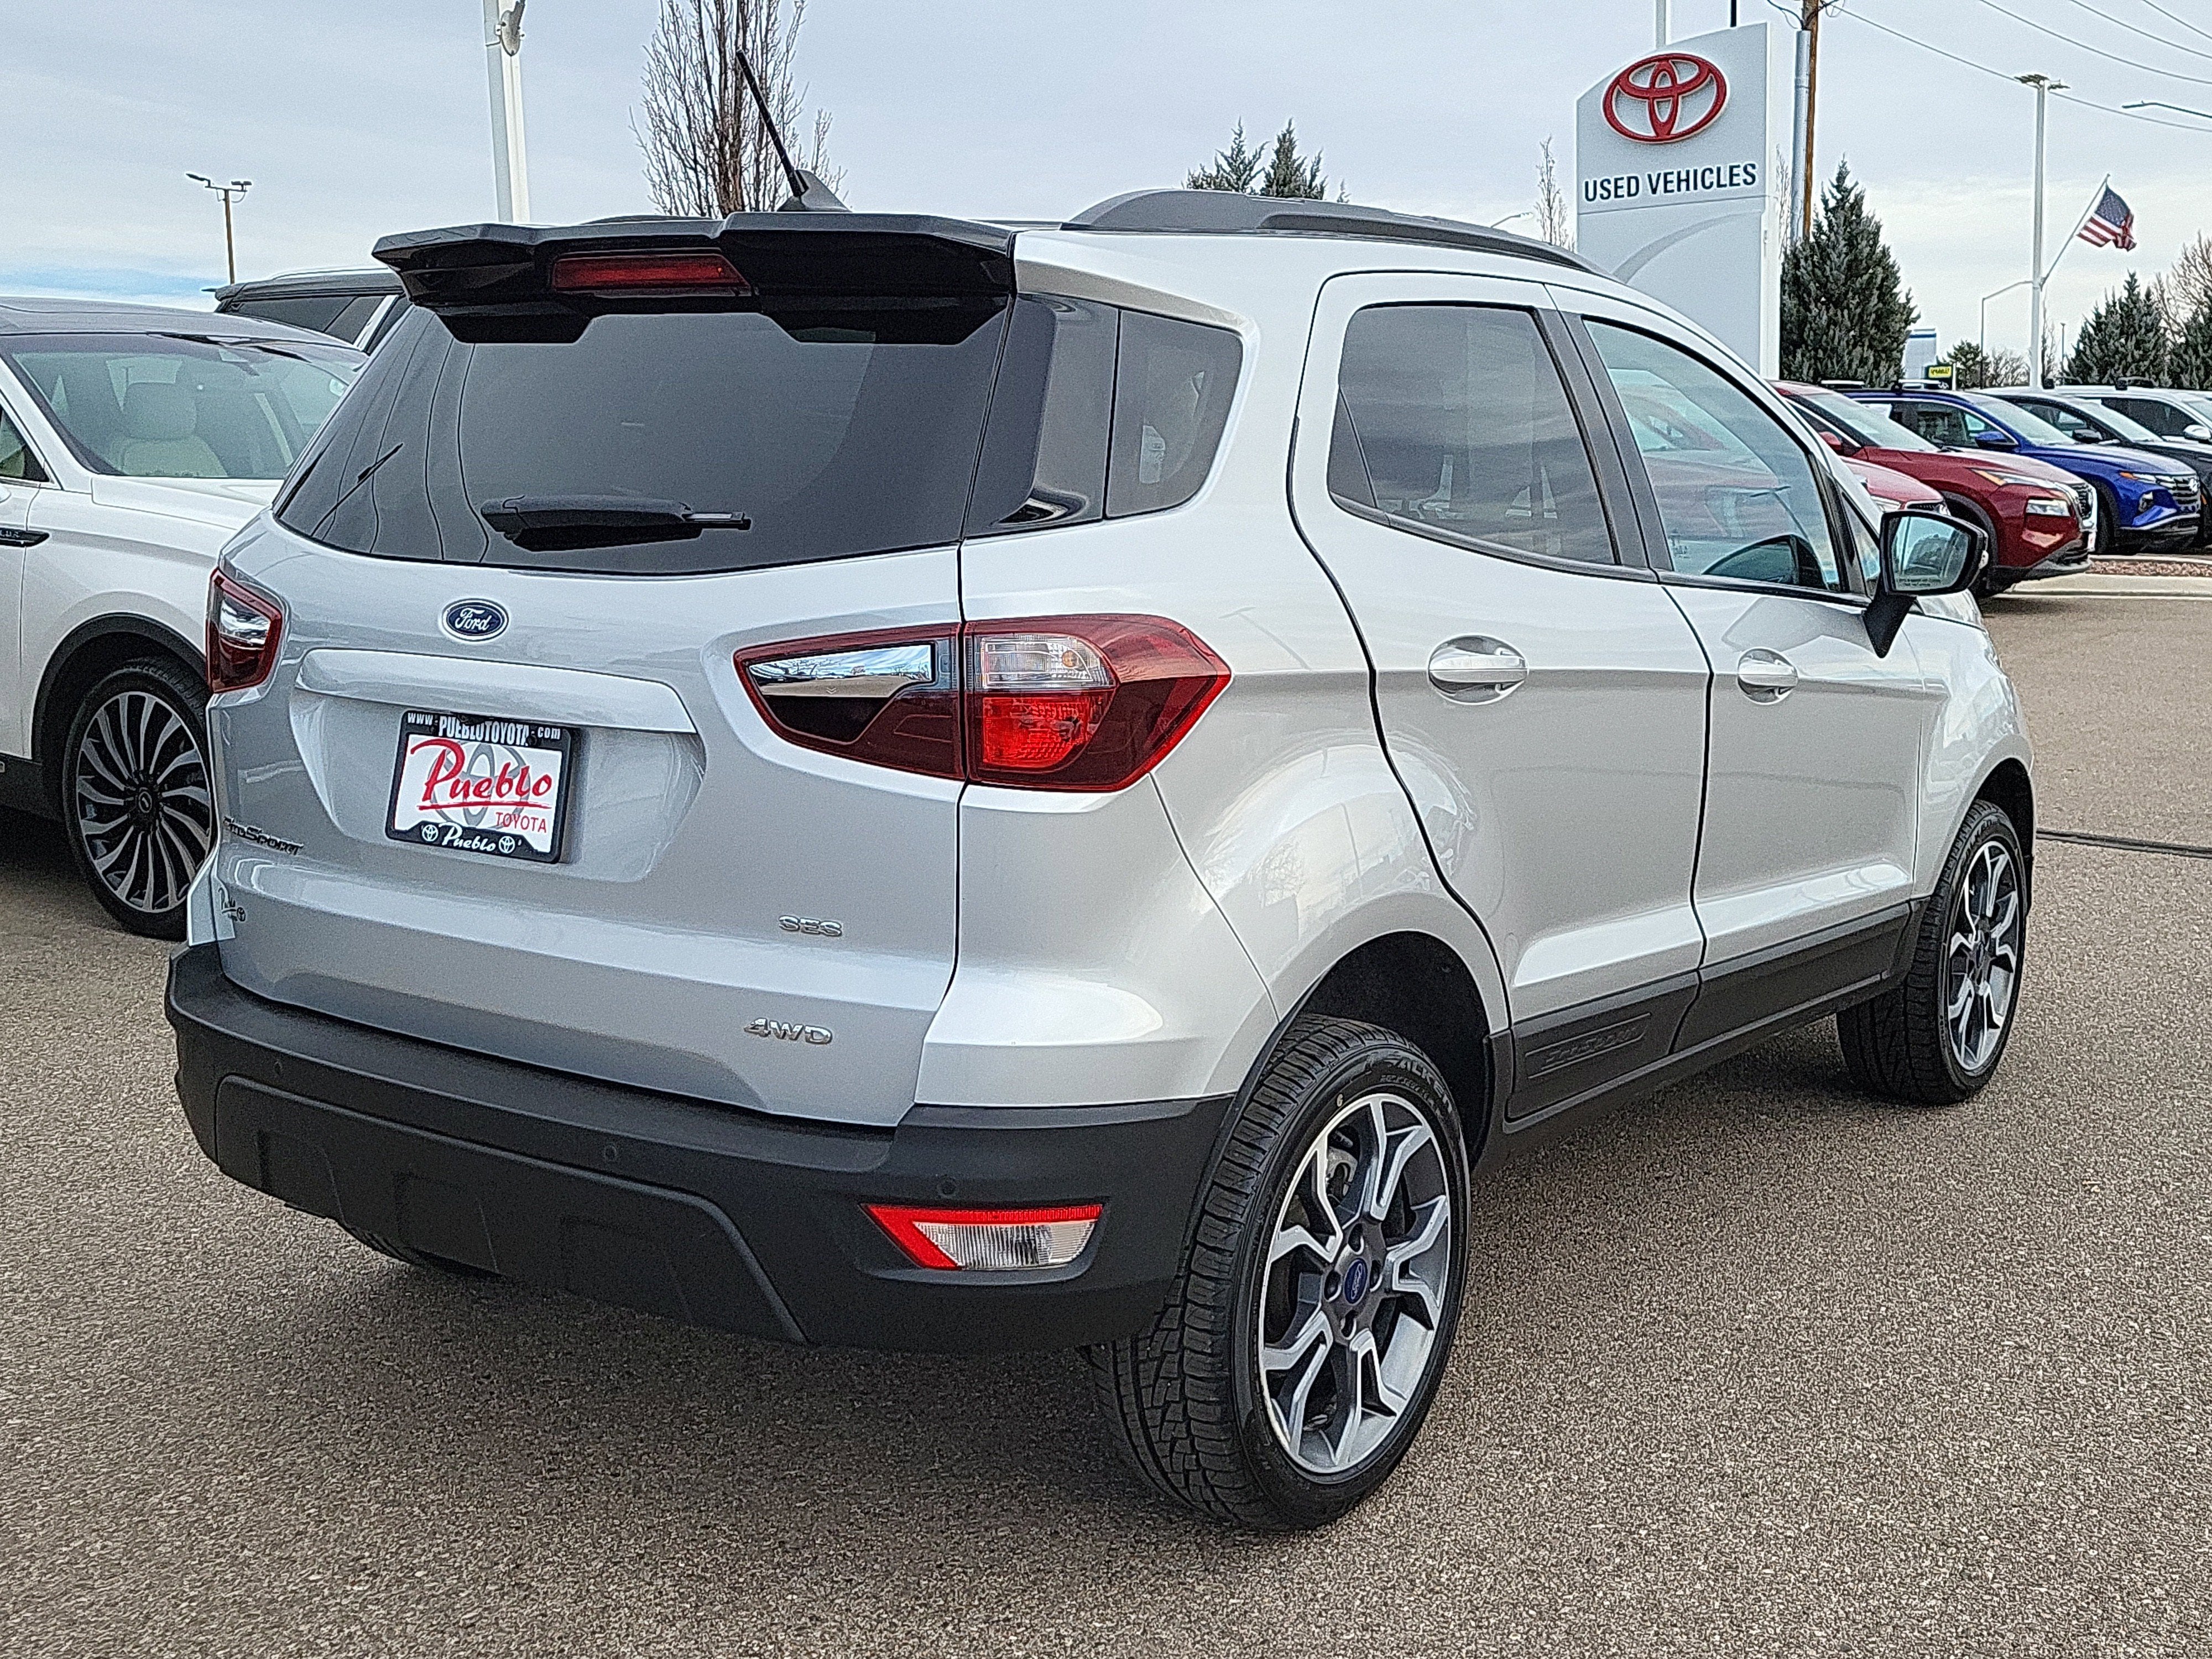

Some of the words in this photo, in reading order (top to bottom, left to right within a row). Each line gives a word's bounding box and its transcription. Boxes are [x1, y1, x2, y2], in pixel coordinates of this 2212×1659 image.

[1584, 173, 1640, 202] USED
[1648, 163, 1757, 196] VEHICLES
[455, 607, 492, 632] Ford
[410, 738, 552, 802] Pueblo
[495, 811, 547, 833] TOYOTA
[439, 822, 497, 852] Pueblo
[778, 914, 842, 937] SES
[744, 1018, 833, 1045] 4WD
